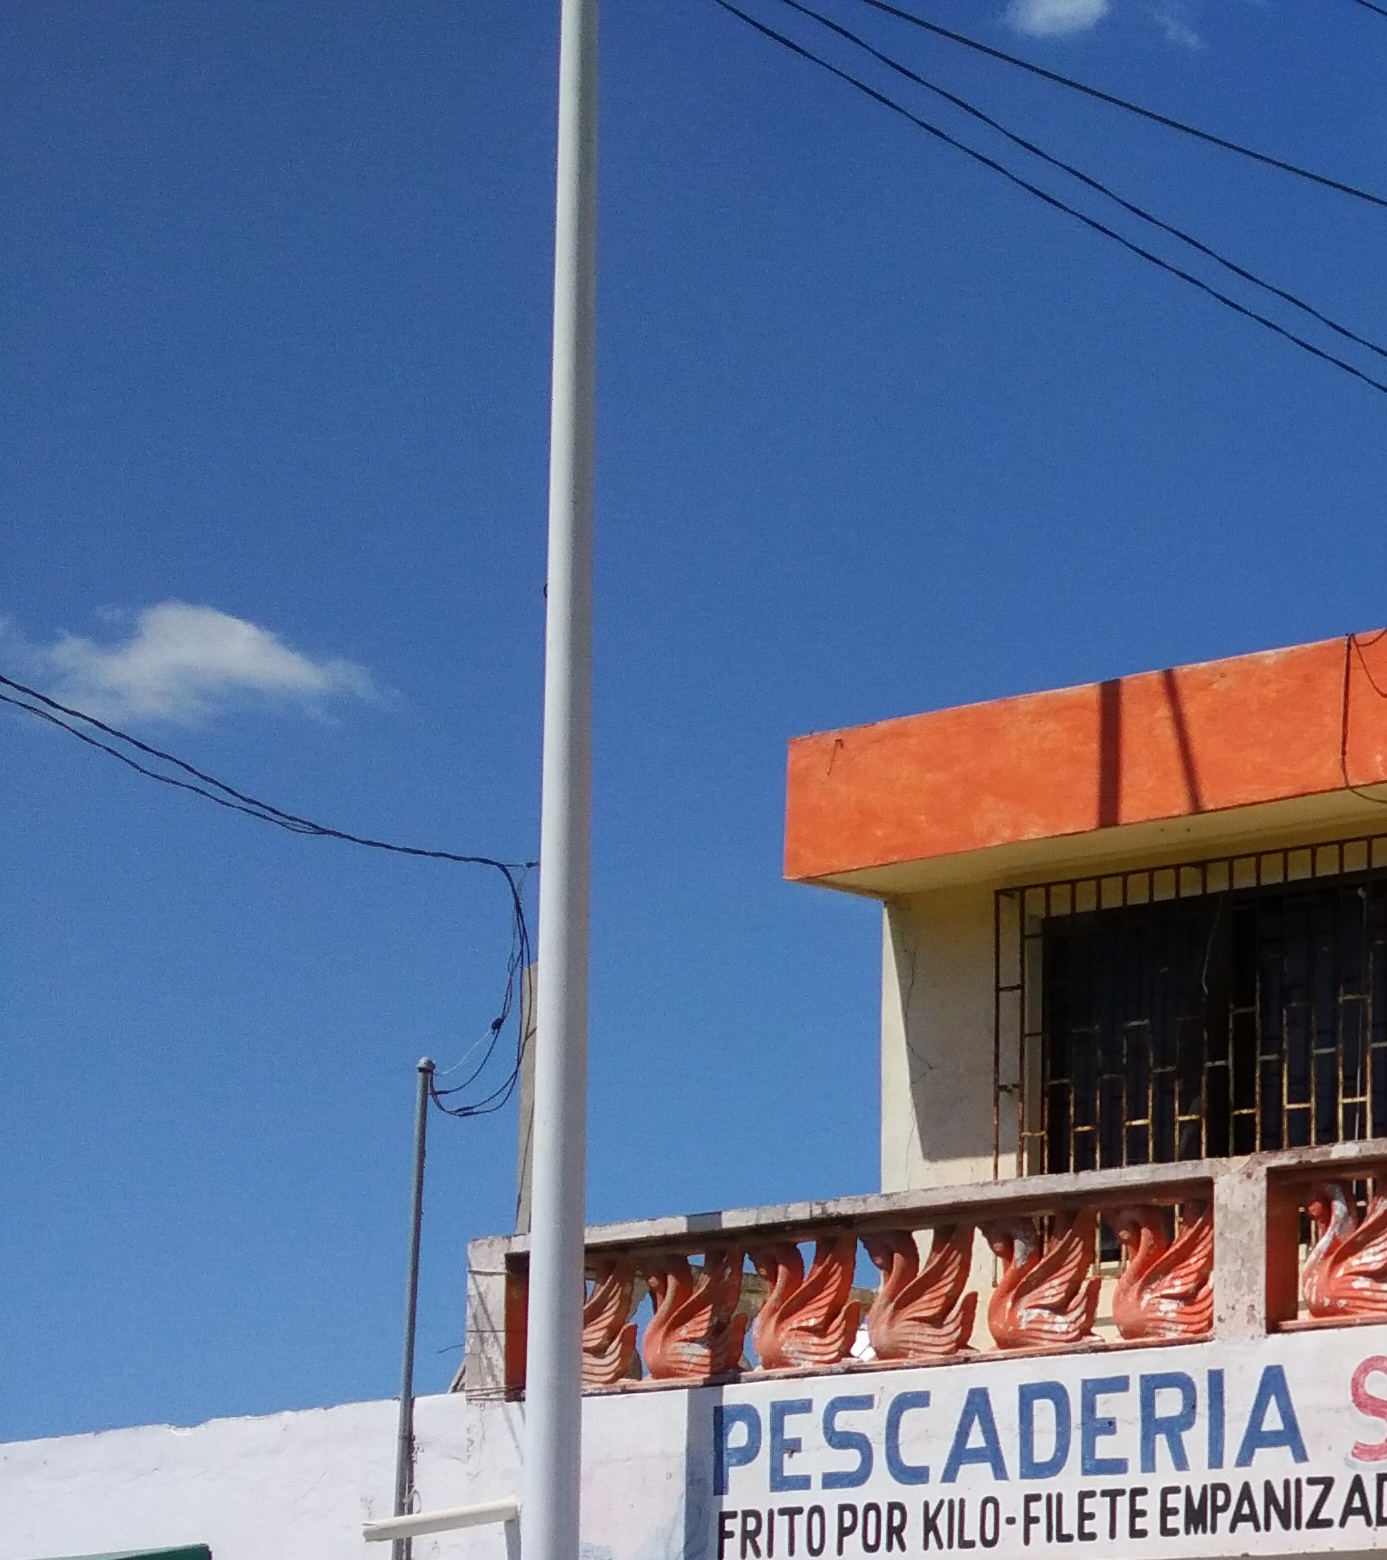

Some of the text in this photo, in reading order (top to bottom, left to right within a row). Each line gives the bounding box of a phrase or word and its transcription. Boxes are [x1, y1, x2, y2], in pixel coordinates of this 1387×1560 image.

[713, 1364, 1309, 1496] PESCADERIA
[717, 1504, 825, 1560] FRITO
[837, 1501, 907, 1556] POR
